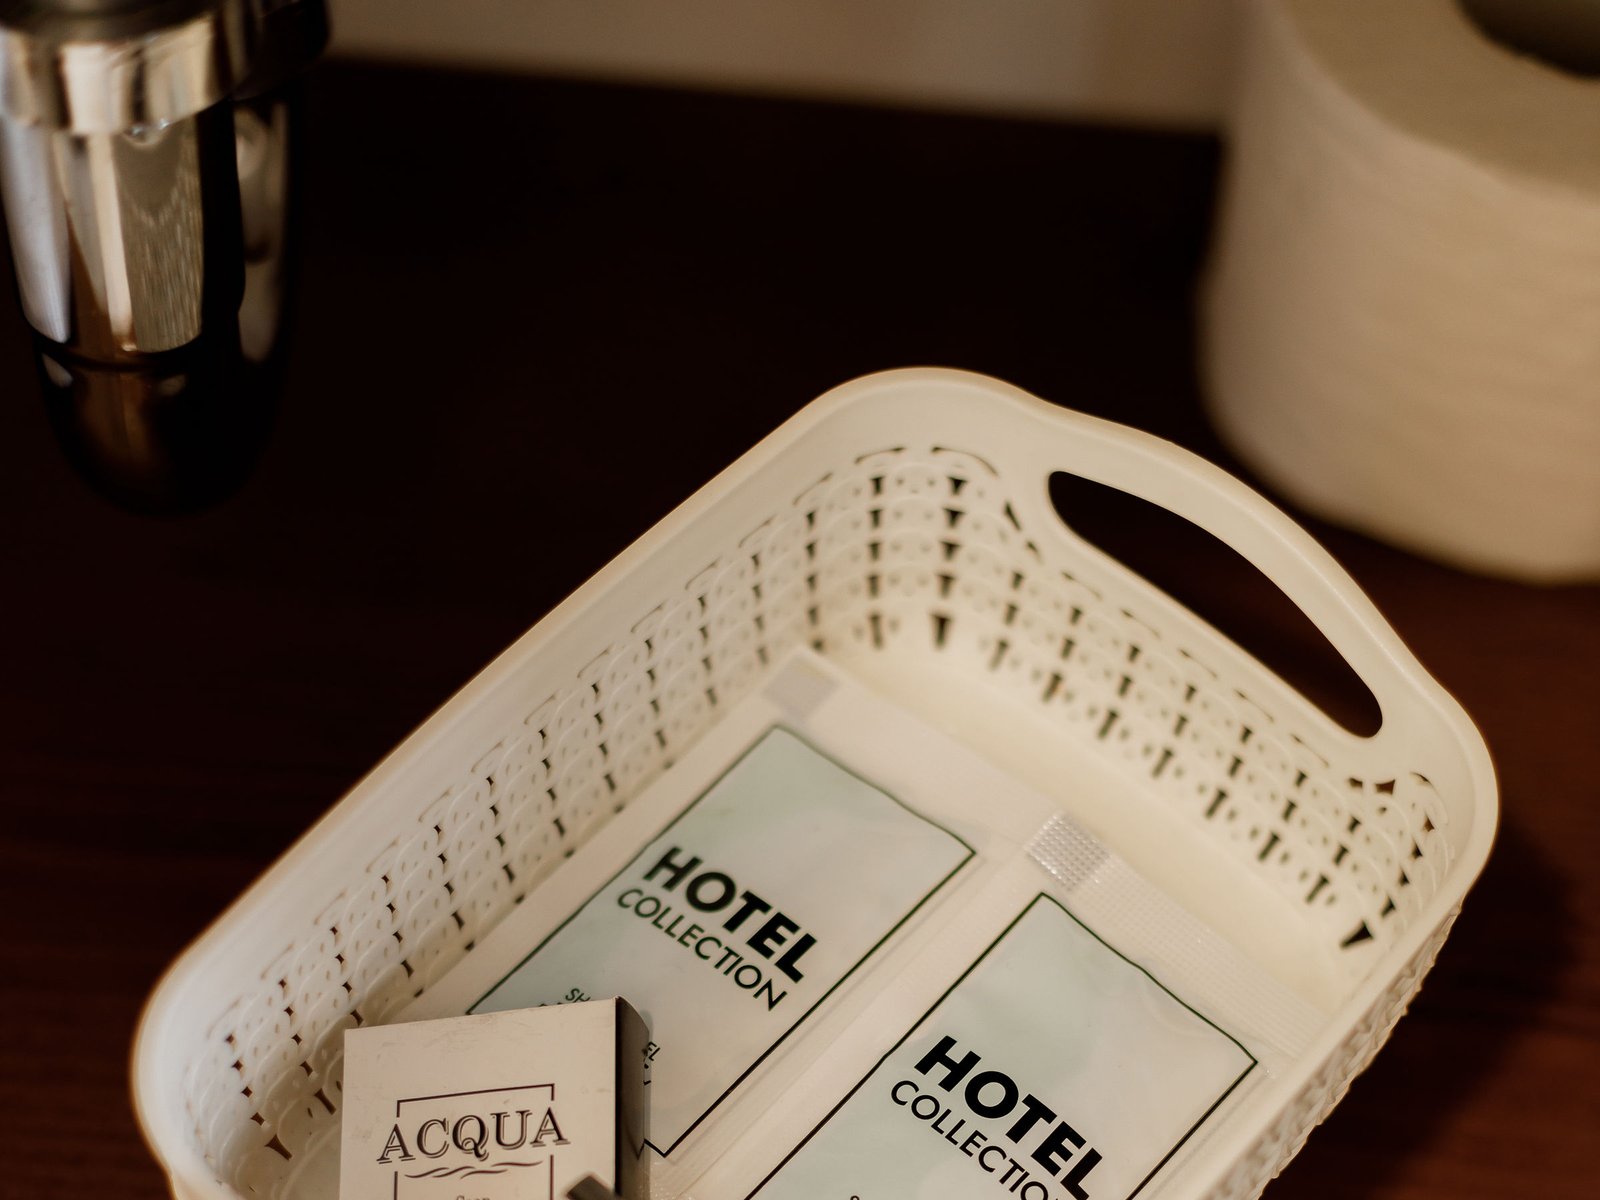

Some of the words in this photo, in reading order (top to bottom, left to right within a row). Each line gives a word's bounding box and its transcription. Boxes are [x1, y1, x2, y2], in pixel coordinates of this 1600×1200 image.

[617, 888, 788, 1011] COLLECTION
[643, 846, 818, 984] HOTEL
[376, 1106, 571, 1164] ACQUA
